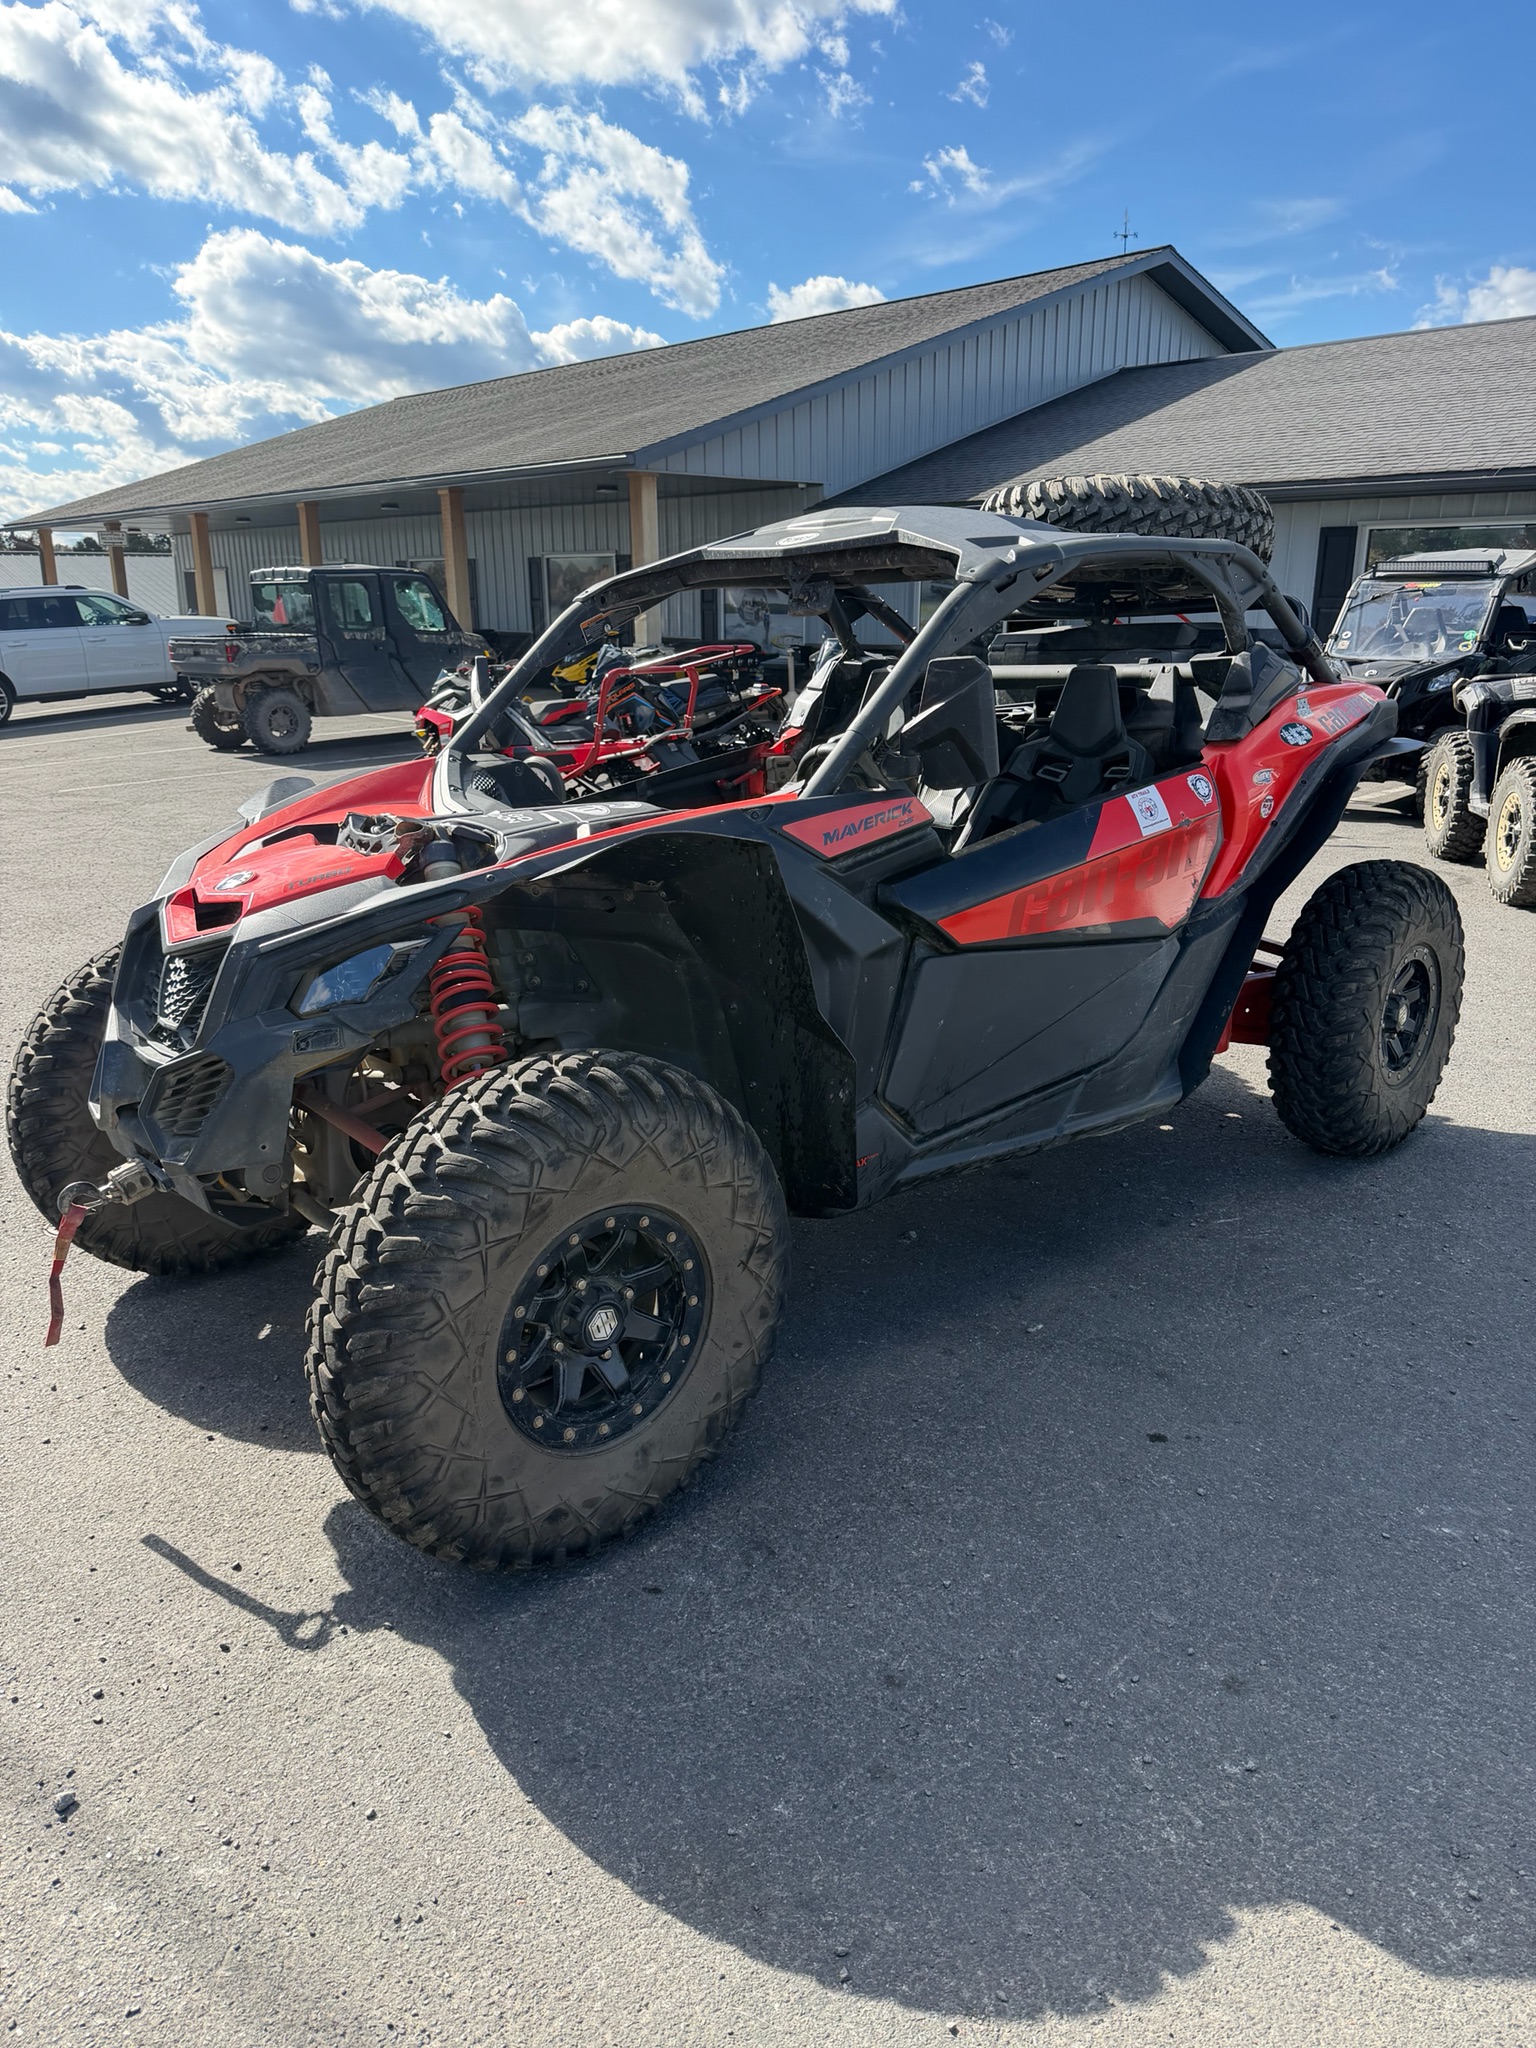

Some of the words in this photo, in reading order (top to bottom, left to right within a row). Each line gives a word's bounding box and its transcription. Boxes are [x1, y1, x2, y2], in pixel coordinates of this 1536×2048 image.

[822, 801, 913, 846] MAVERICK
[898, 817, 914, 828] DS
[287, 866, 352, 890] TURBO
